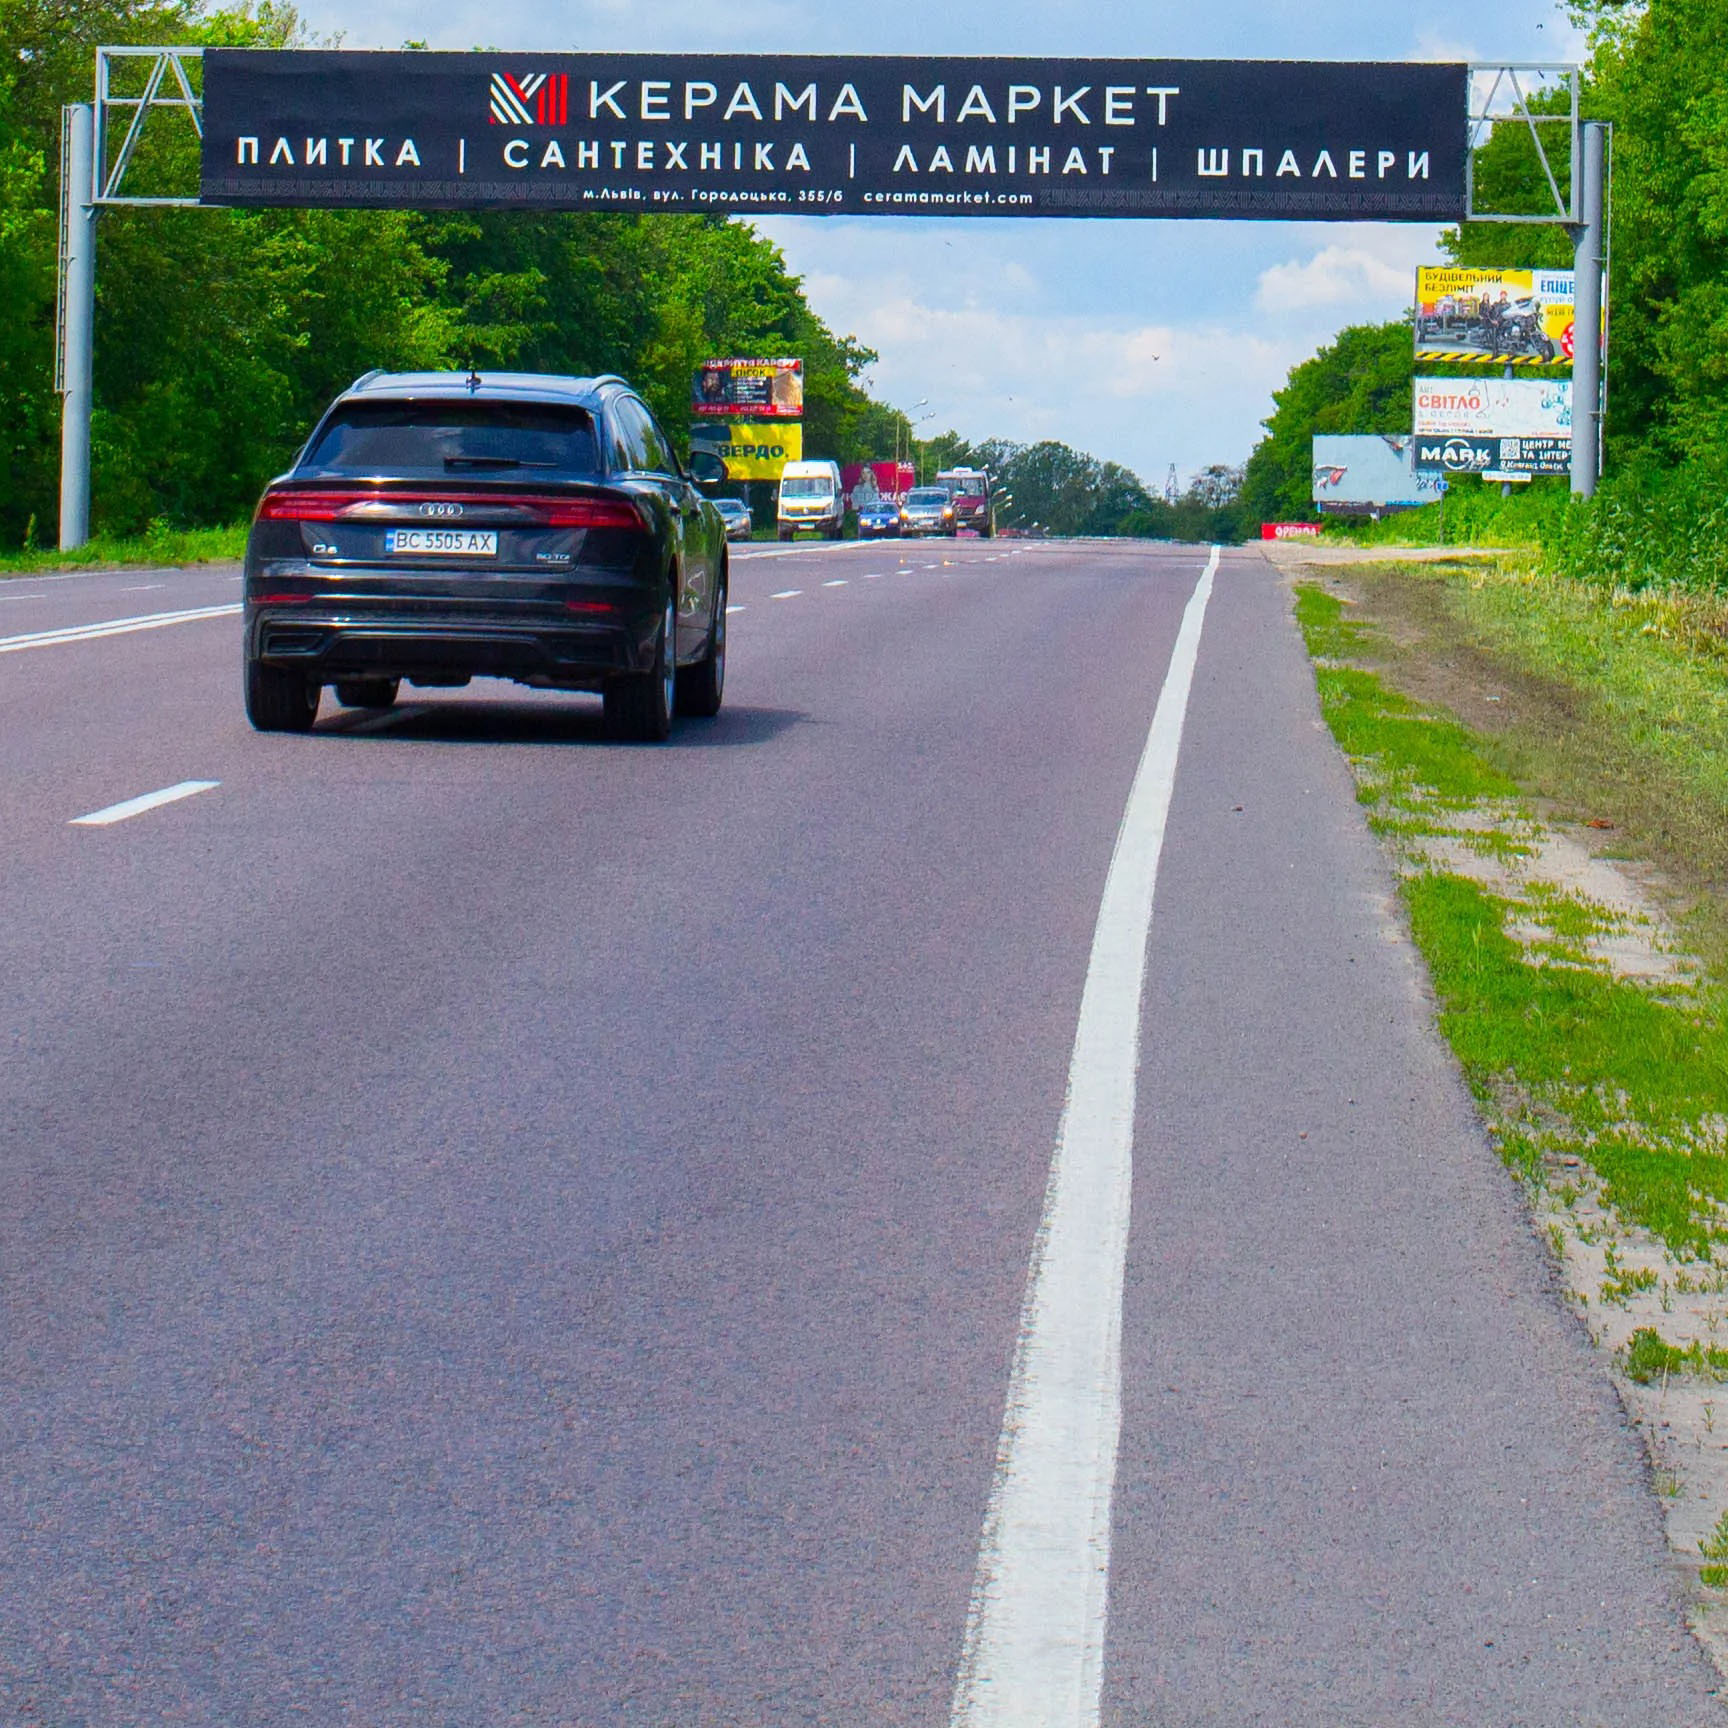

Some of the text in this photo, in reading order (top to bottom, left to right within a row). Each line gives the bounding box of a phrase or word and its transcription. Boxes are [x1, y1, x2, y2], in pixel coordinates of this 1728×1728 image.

[589, 80, 1180, 126] КЕРАМА МАРКЕТ
[237, 136, 1430, 179] ПЛИТКА САНТЕХНІКА ЛАМІНАТ ШПАЛЕРИ
[653, 191, 685, 203] вул.
[691, 188, 792, 204] Городоцька,
[864, 190, 1033, 204] ceramamarket.com
[1418, 394, 1481, 410] СВІТЛО
[396, 532, 492, 551] BC 5505 AX
